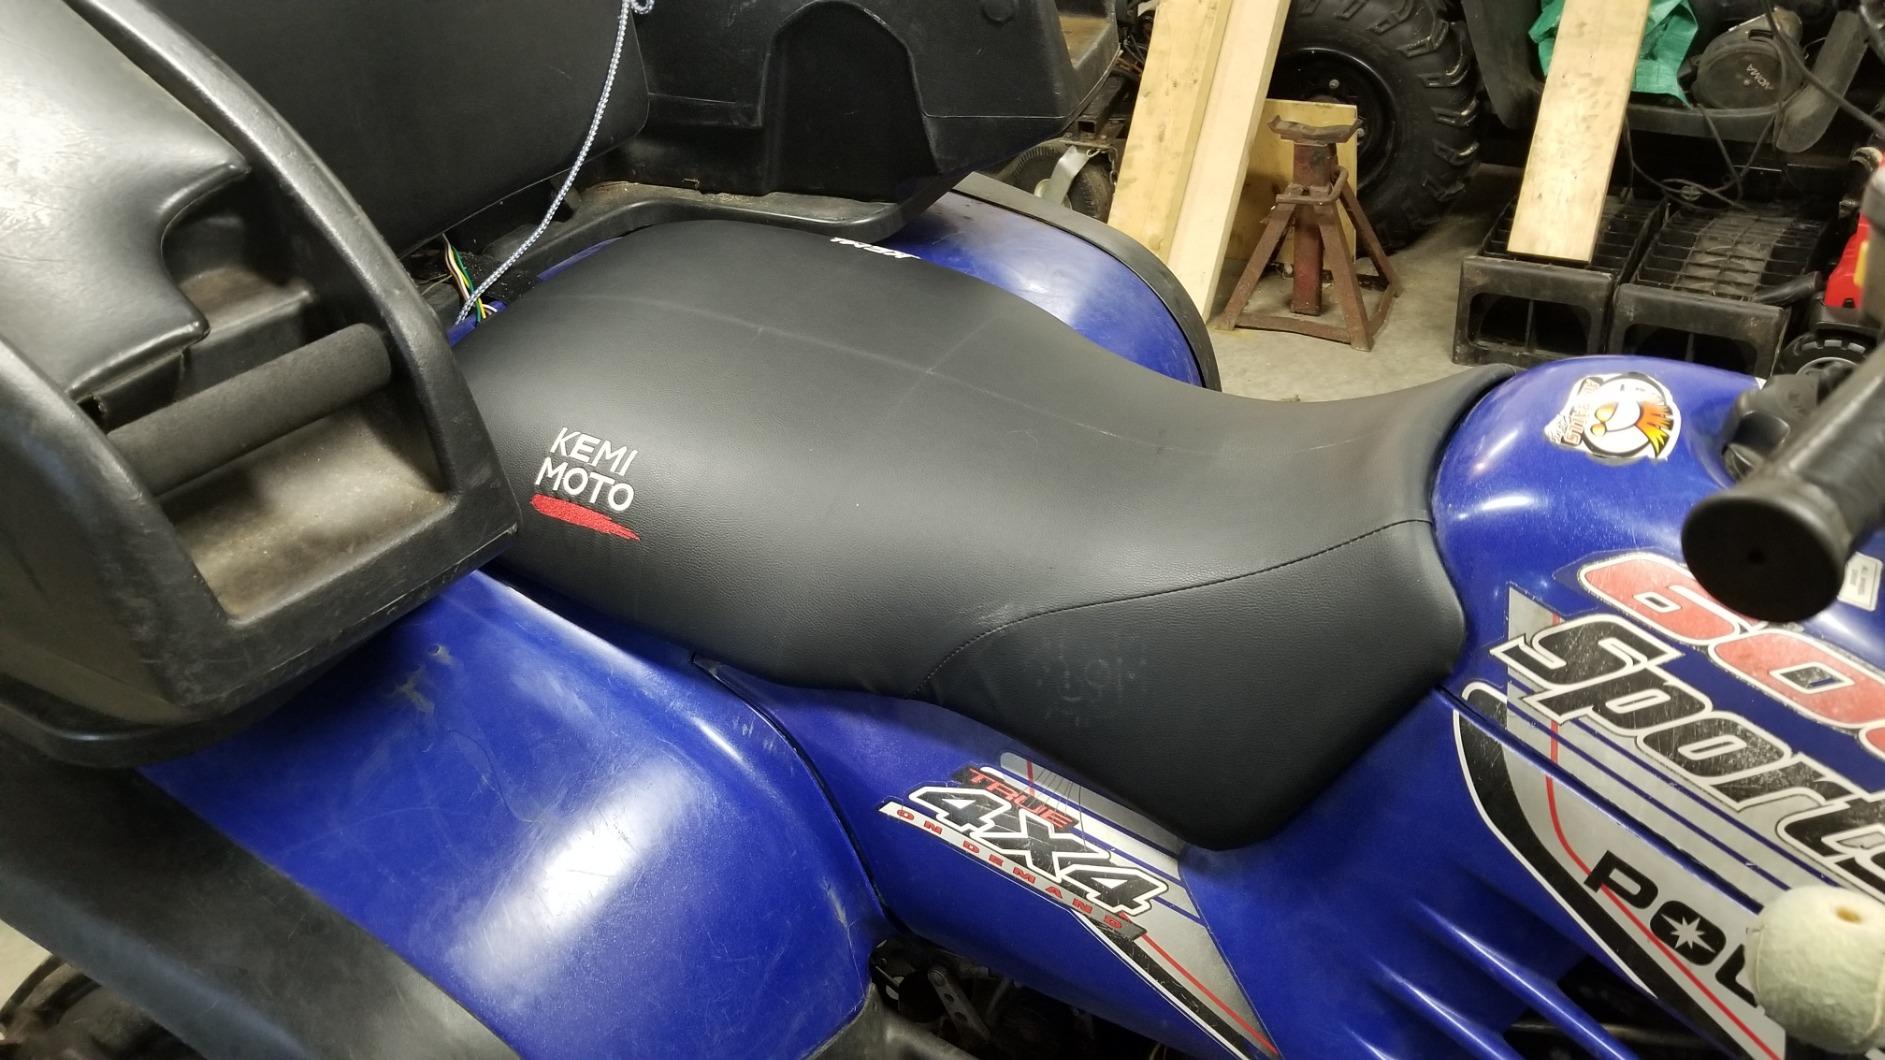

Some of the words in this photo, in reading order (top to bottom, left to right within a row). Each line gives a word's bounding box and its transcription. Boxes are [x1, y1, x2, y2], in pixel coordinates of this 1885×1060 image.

[534, 456, 635, 511] MOTO
[550, 427, 638, 477] KEMI
[1577, 552, 1885, 764] 60
[968, 768, 1073, 829] TRUE
[1489, 614, 1885, 902] Sport
[896, 808, 943, 836] ON
[962, 840, 1123, 930] DEMAND
[909, 786, 1168, 916] 4X4
[1584, 850, 1758, 1009] POL
